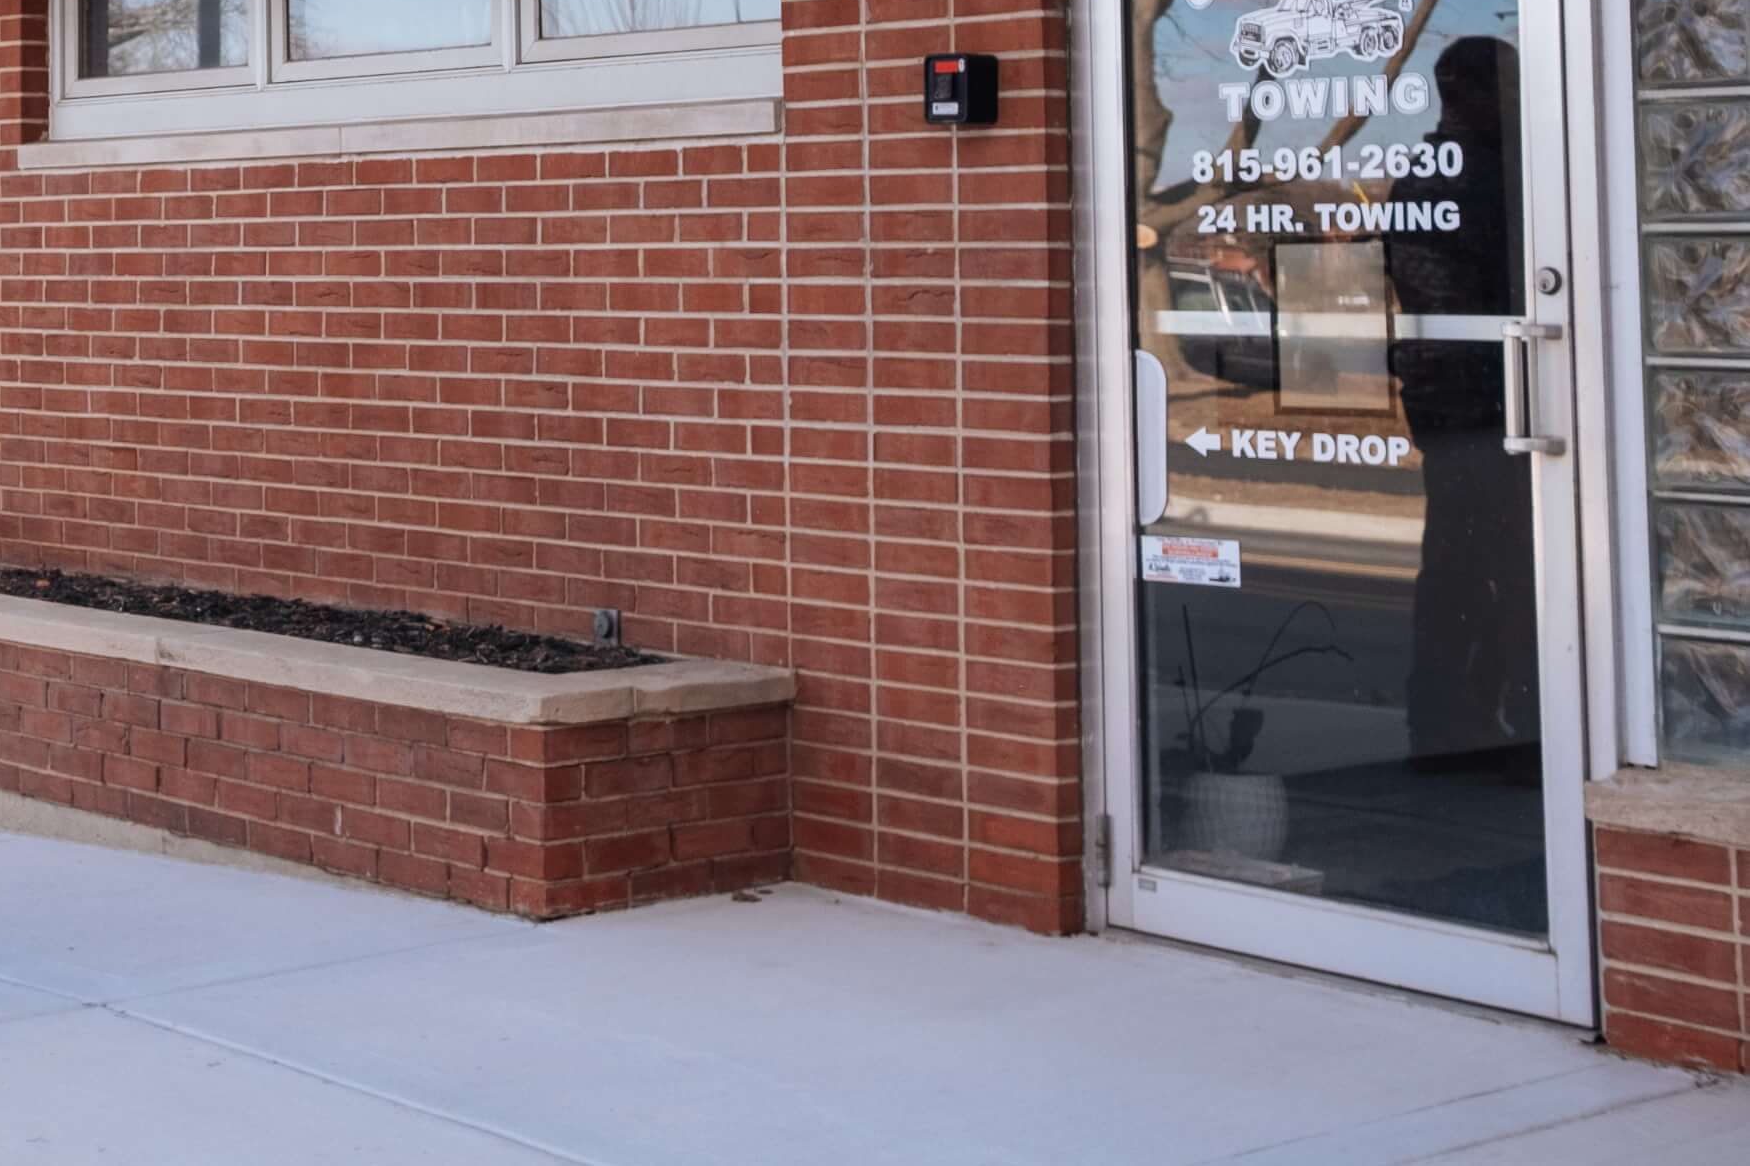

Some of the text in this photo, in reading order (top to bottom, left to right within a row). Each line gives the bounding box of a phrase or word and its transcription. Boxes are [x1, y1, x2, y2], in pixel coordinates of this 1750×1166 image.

[1218, 72, 1430, 123] TOWING
[1191, 140, 1464, 184] 815-961-2630
[1197, 200, 1461, 234] 24 HR. TOWING
[1230, 428, 1411, 467] KEY DROP
